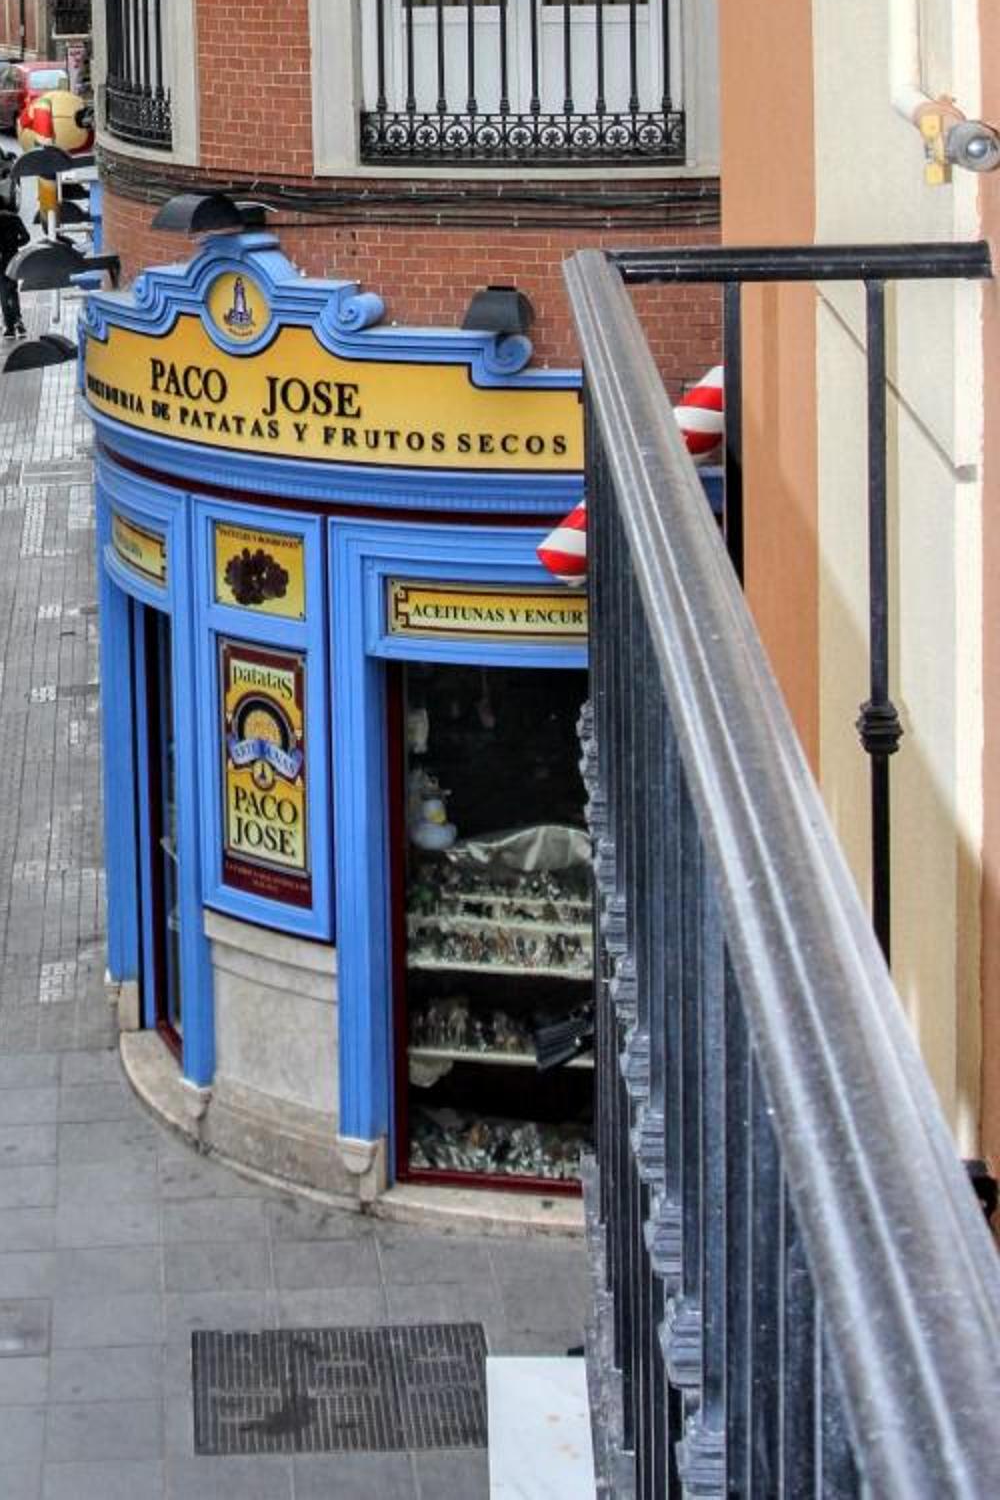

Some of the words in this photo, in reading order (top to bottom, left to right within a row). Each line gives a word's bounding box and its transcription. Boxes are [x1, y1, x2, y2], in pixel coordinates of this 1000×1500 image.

[150, 358, 228, 403] PACO
[262, 375, 361, 418] JOSE
[151, 400, 170, 420] DE
[179, 406, 279, 439] PATATAS
[293, 422, 307, 441] Y
[323, 426, 446, 451] FRUTOS
[457, 433, 567, 454] SECOS
[412, 603, 505, 623] ACEITUNAS
[509, 608, 520, 623] Y
[234, 785, 298, 825] PACO
[233, 815, 296, 858] JOSE
